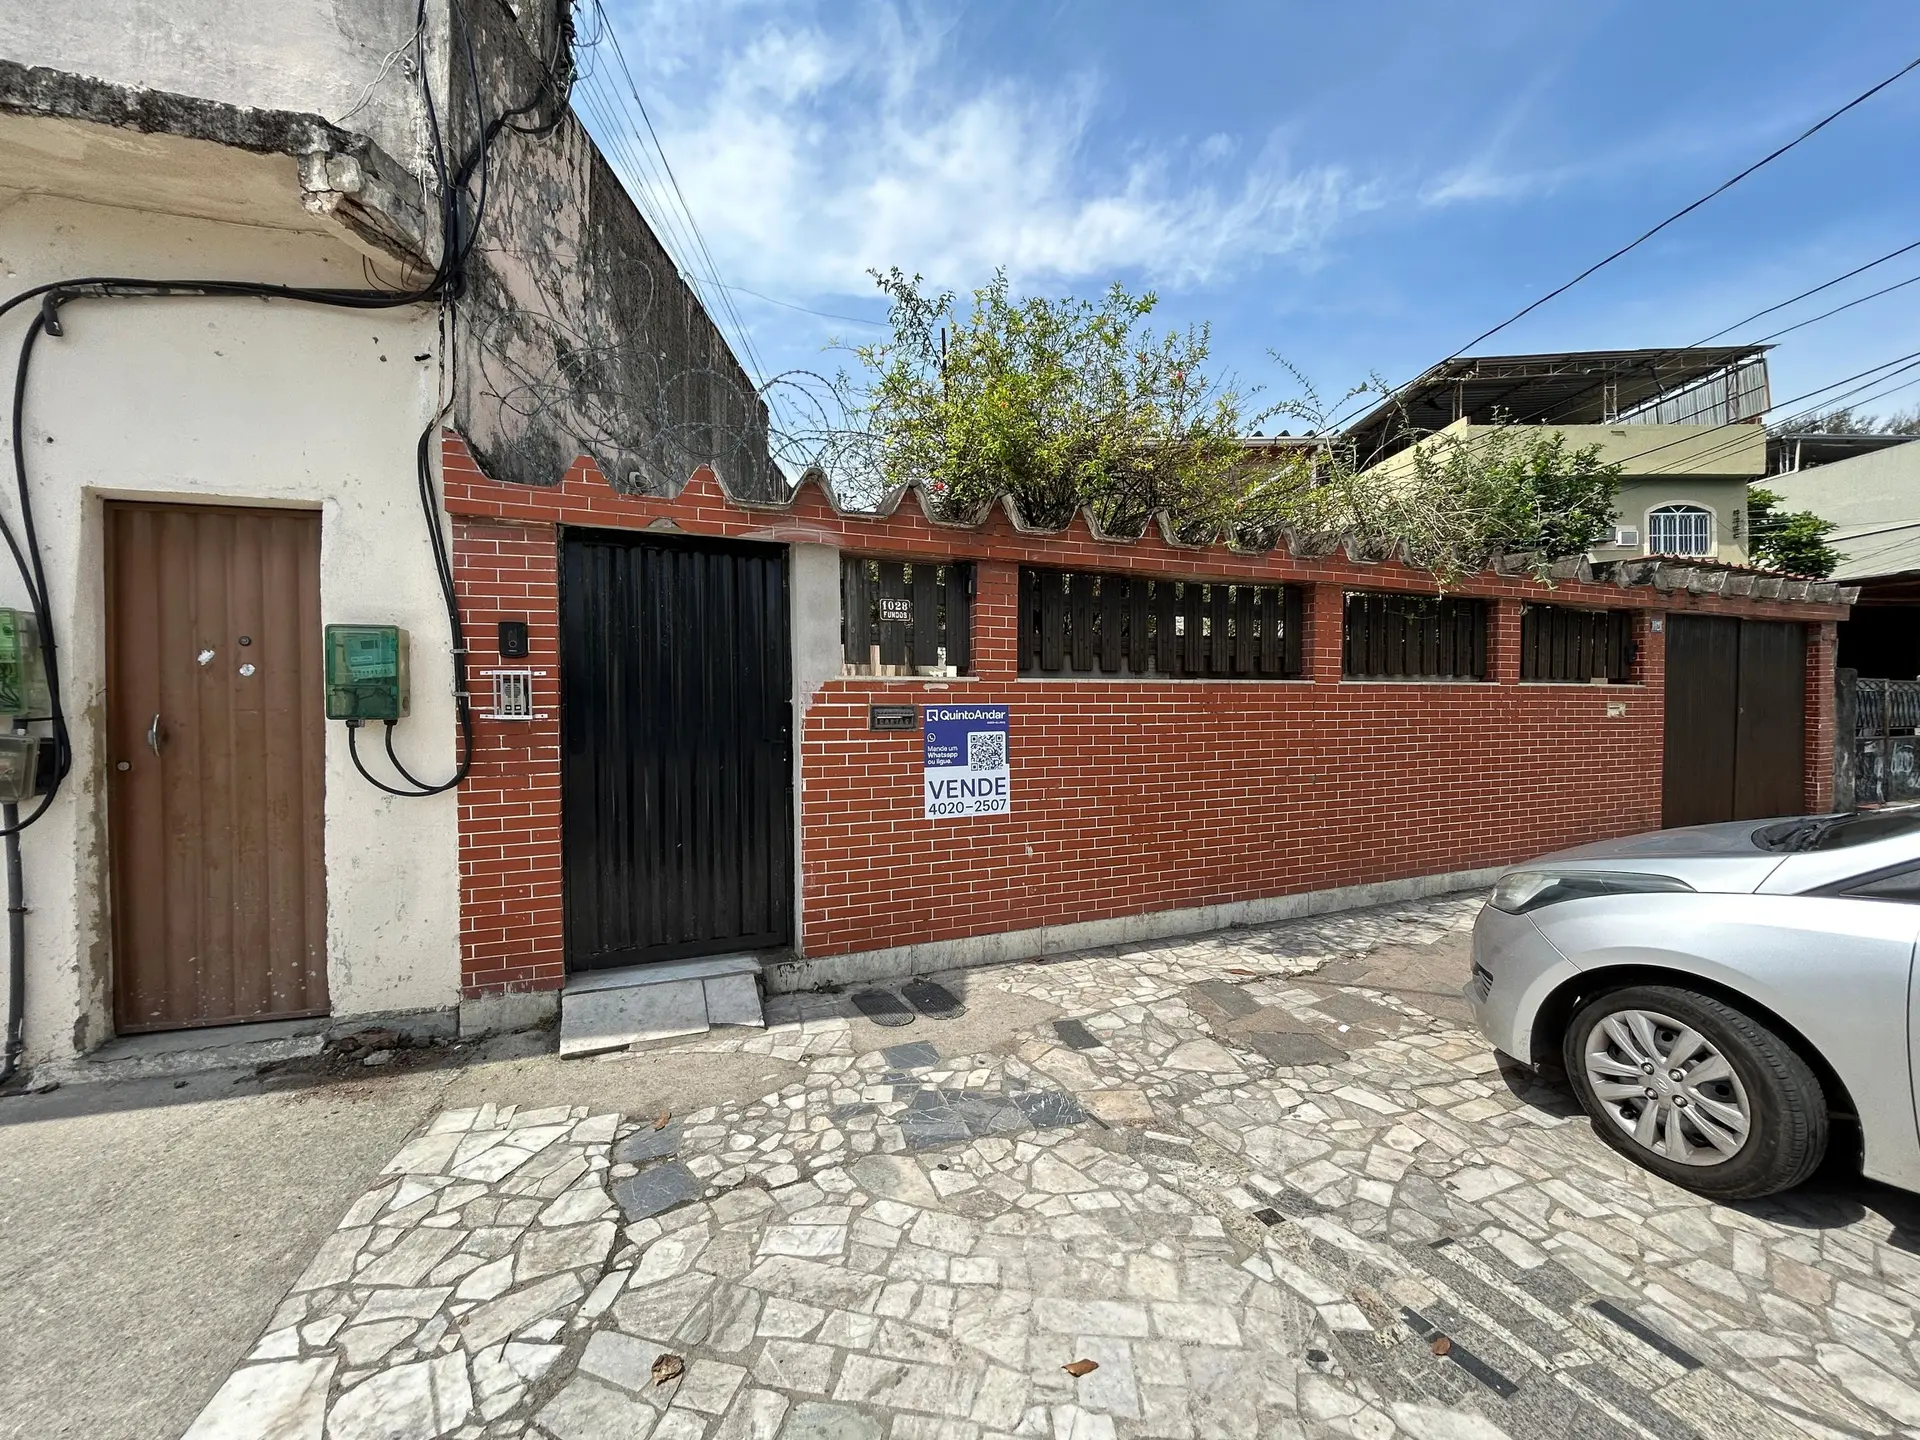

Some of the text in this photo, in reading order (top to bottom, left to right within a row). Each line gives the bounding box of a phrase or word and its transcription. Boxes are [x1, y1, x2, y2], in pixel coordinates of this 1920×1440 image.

[882, 601, 908, 610] 1028
[940, 709, 1006, 720] QuintoAndar
[928, 777, 1006, 799] VENDE
[928, 799, 1006, 815] 4020-2507
